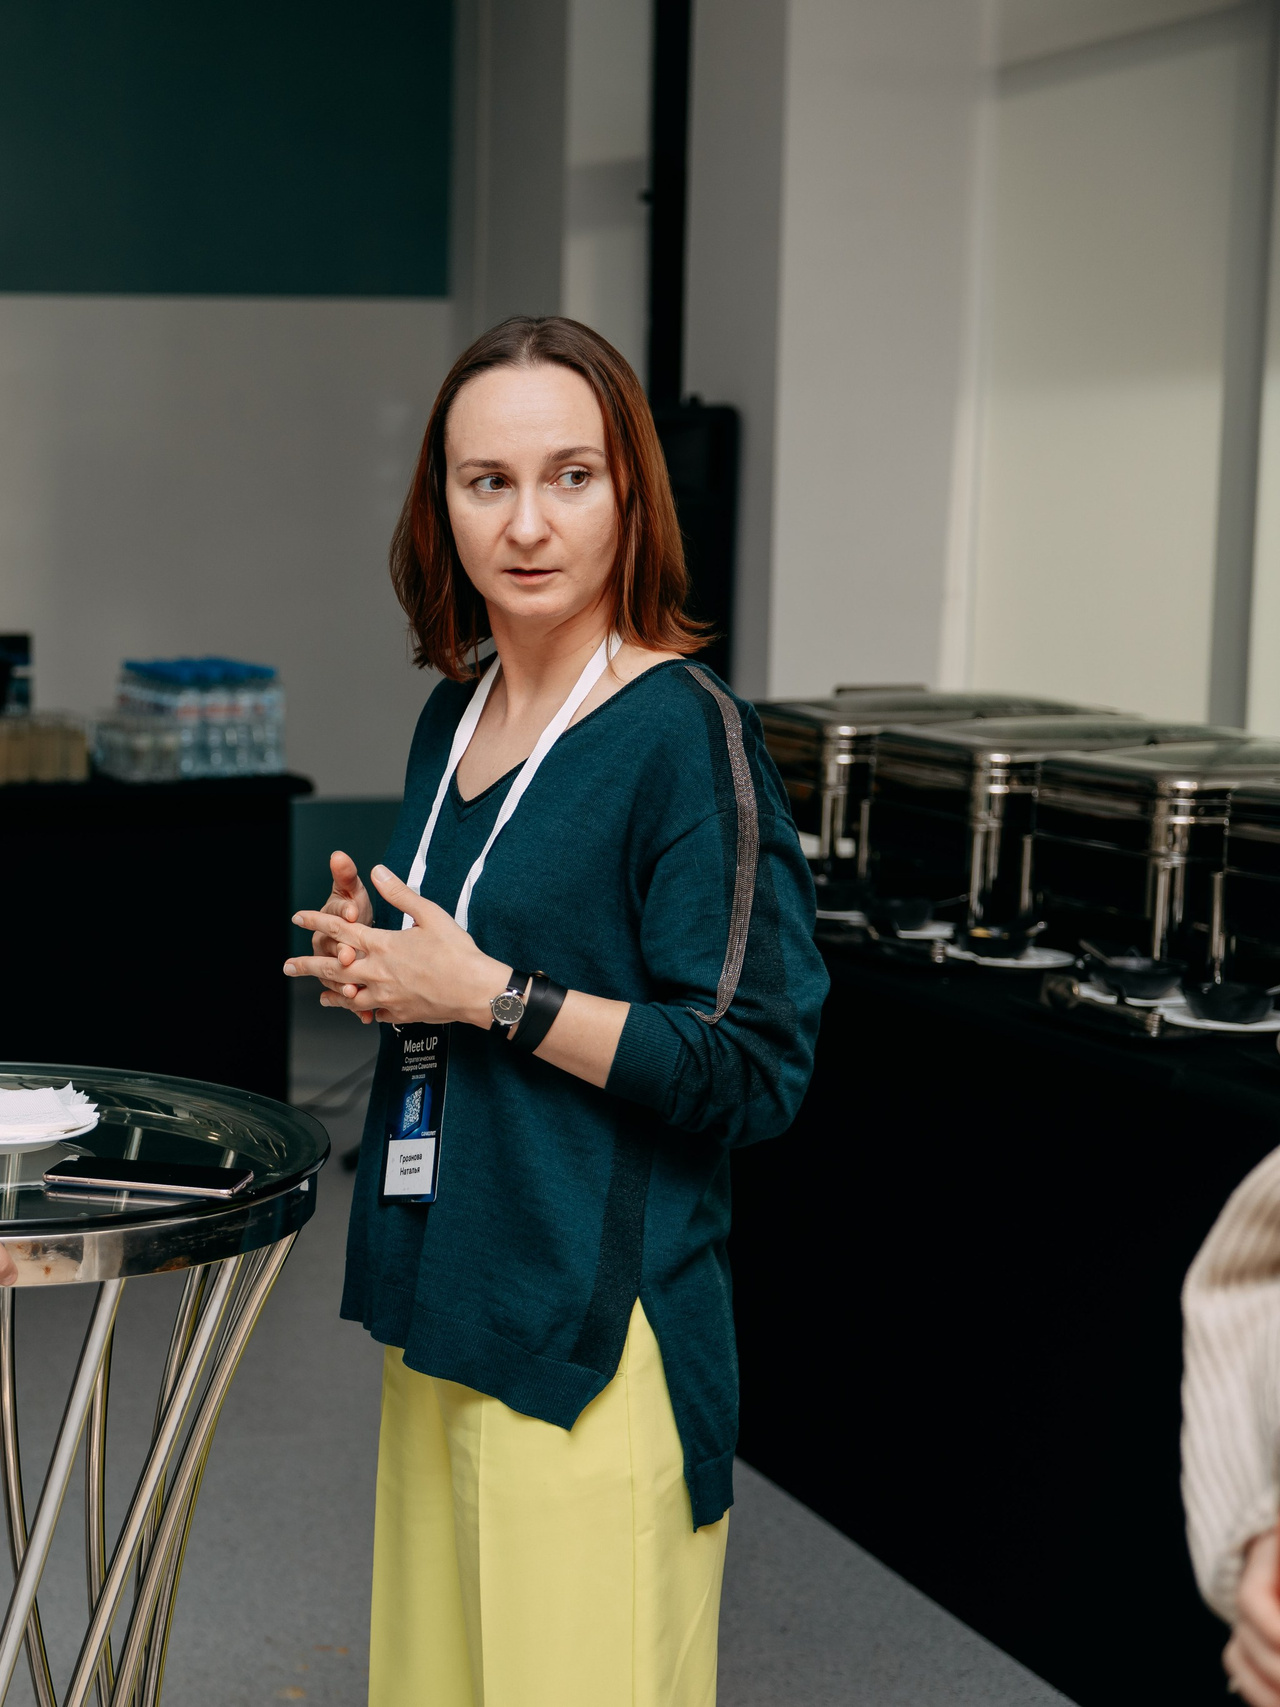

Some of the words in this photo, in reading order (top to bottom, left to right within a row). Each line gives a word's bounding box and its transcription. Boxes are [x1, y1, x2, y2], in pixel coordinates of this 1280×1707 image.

[403, 1039, 425, 1054] Meet
[425, 1036, 438, 1051] UP
[399, 1166, 420, 1176] Наталья
